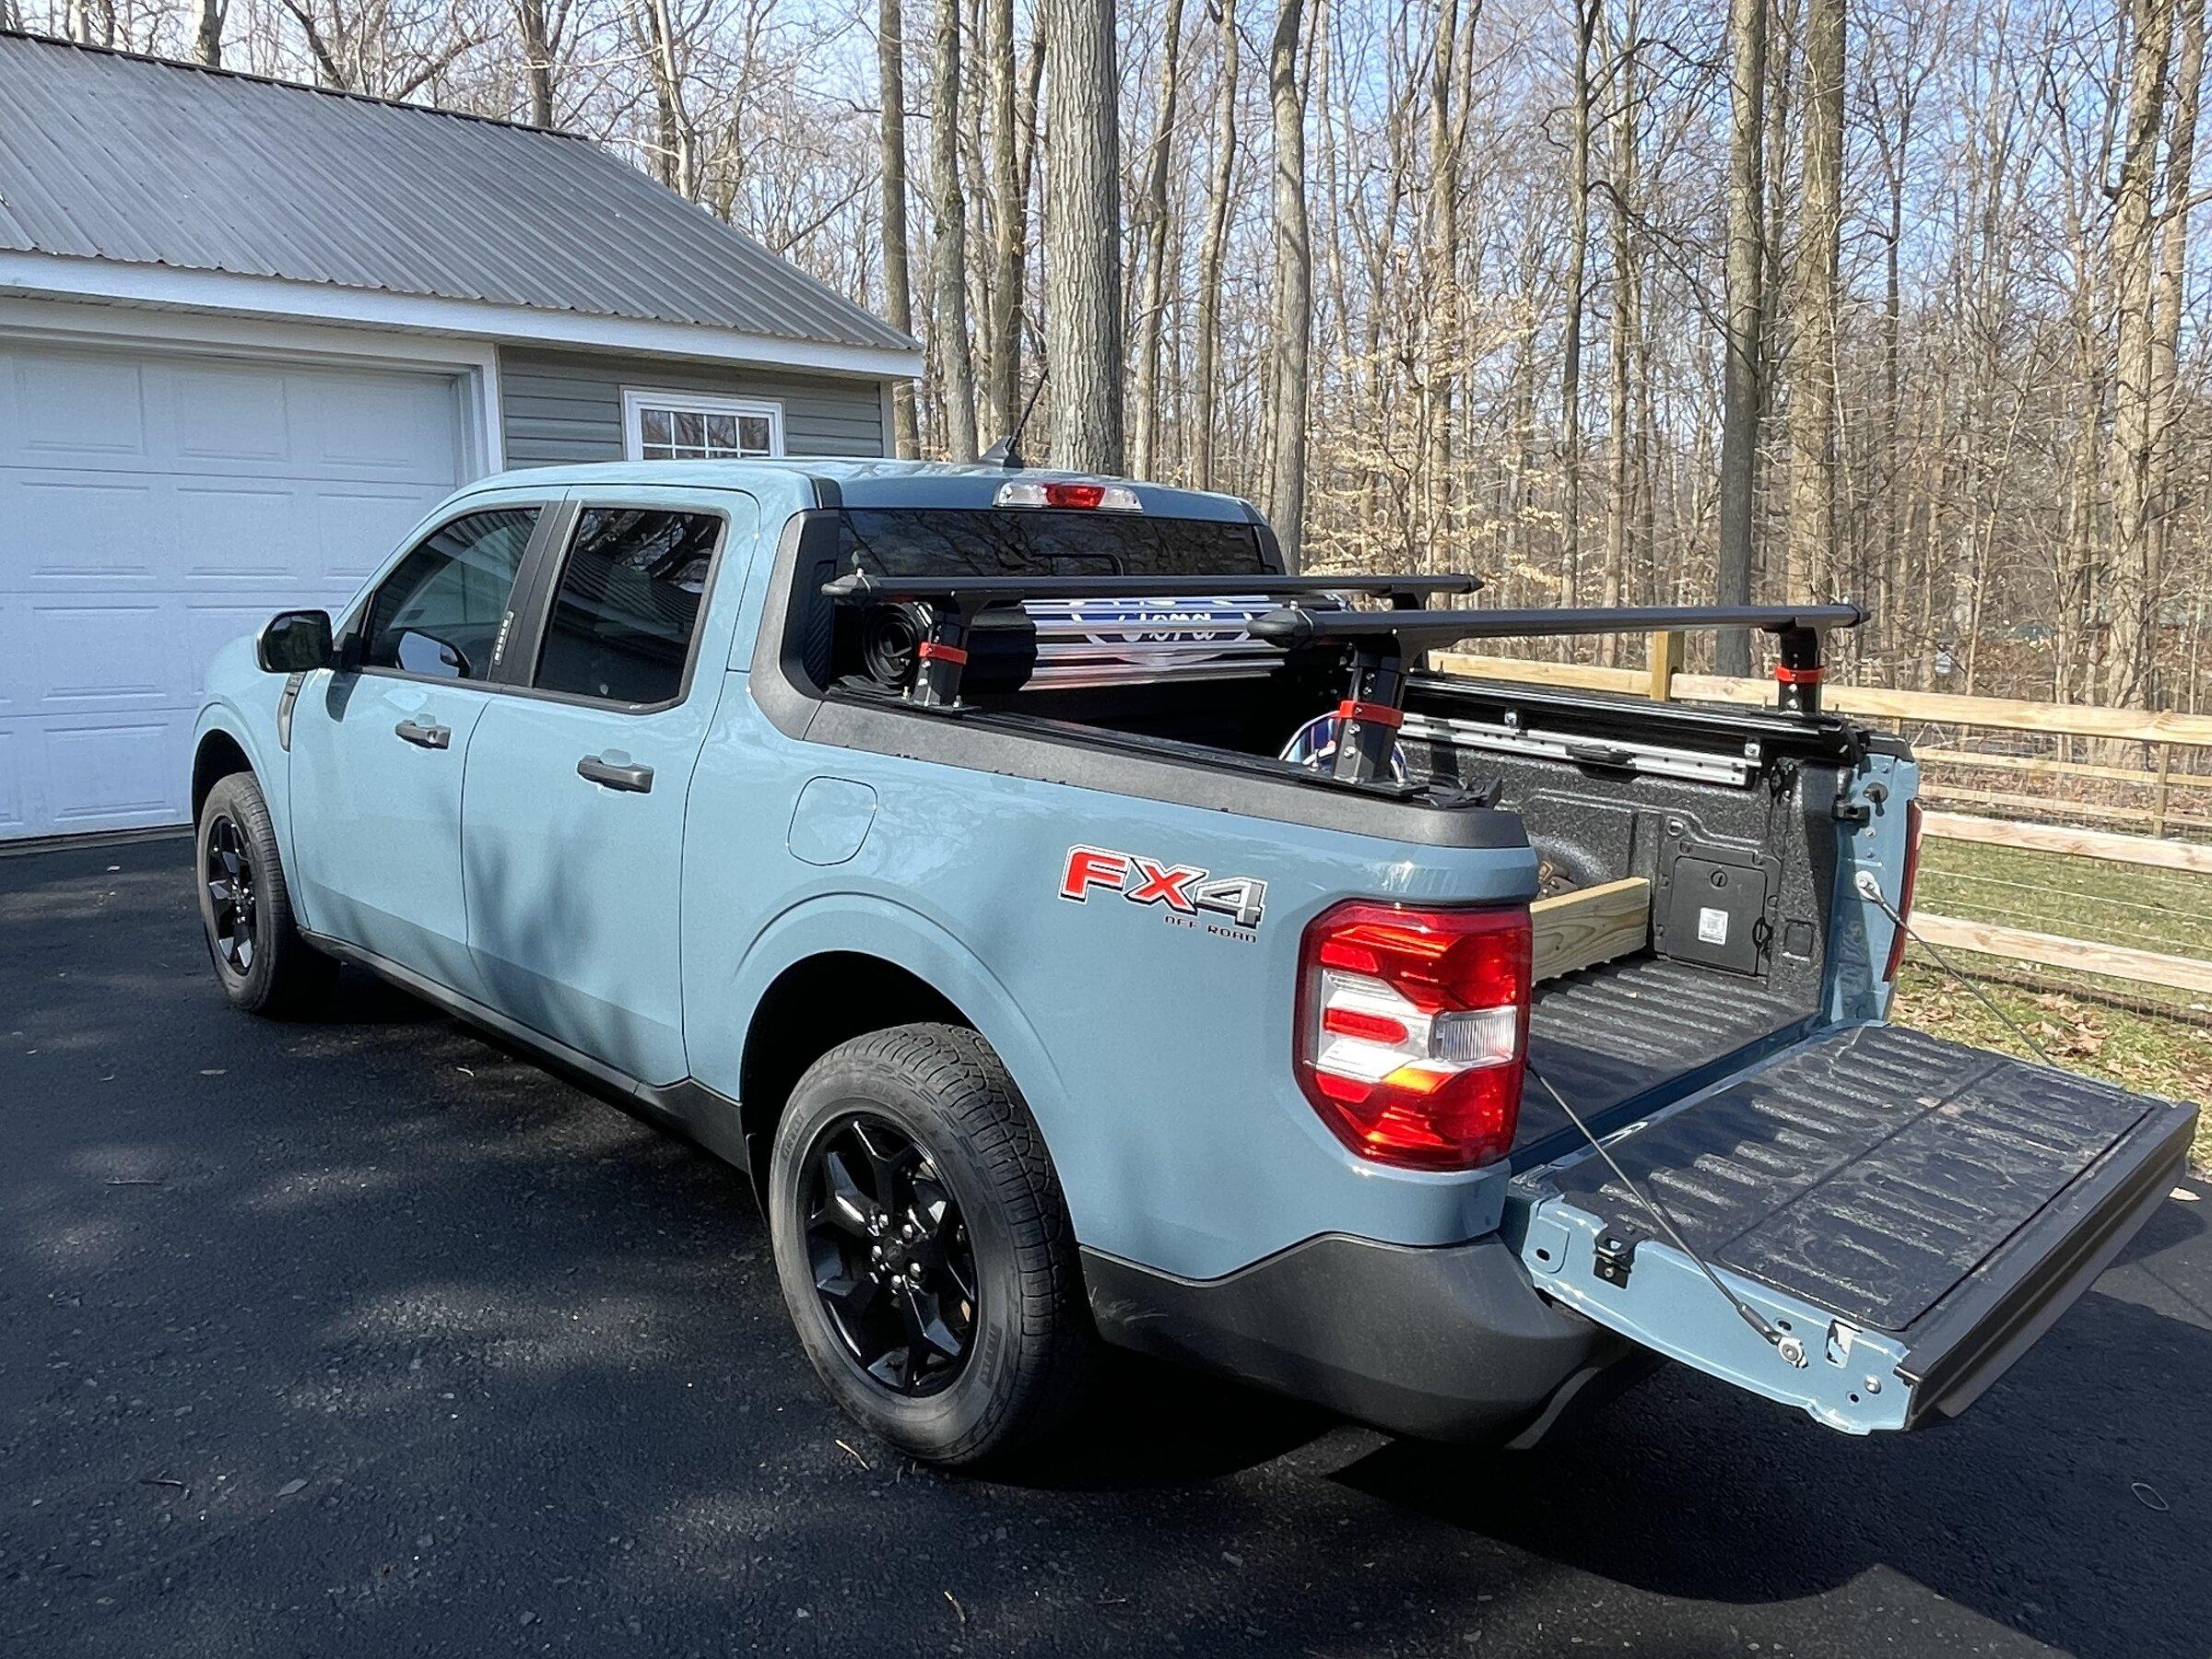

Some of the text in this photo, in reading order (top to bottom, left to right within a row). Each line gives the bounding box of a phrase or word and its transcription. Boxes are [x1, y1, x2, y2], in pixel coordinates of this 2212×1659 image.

[1059, 844, 1267, 929] FX4
[1165, 915, 1257, 943] OFF ROAD
